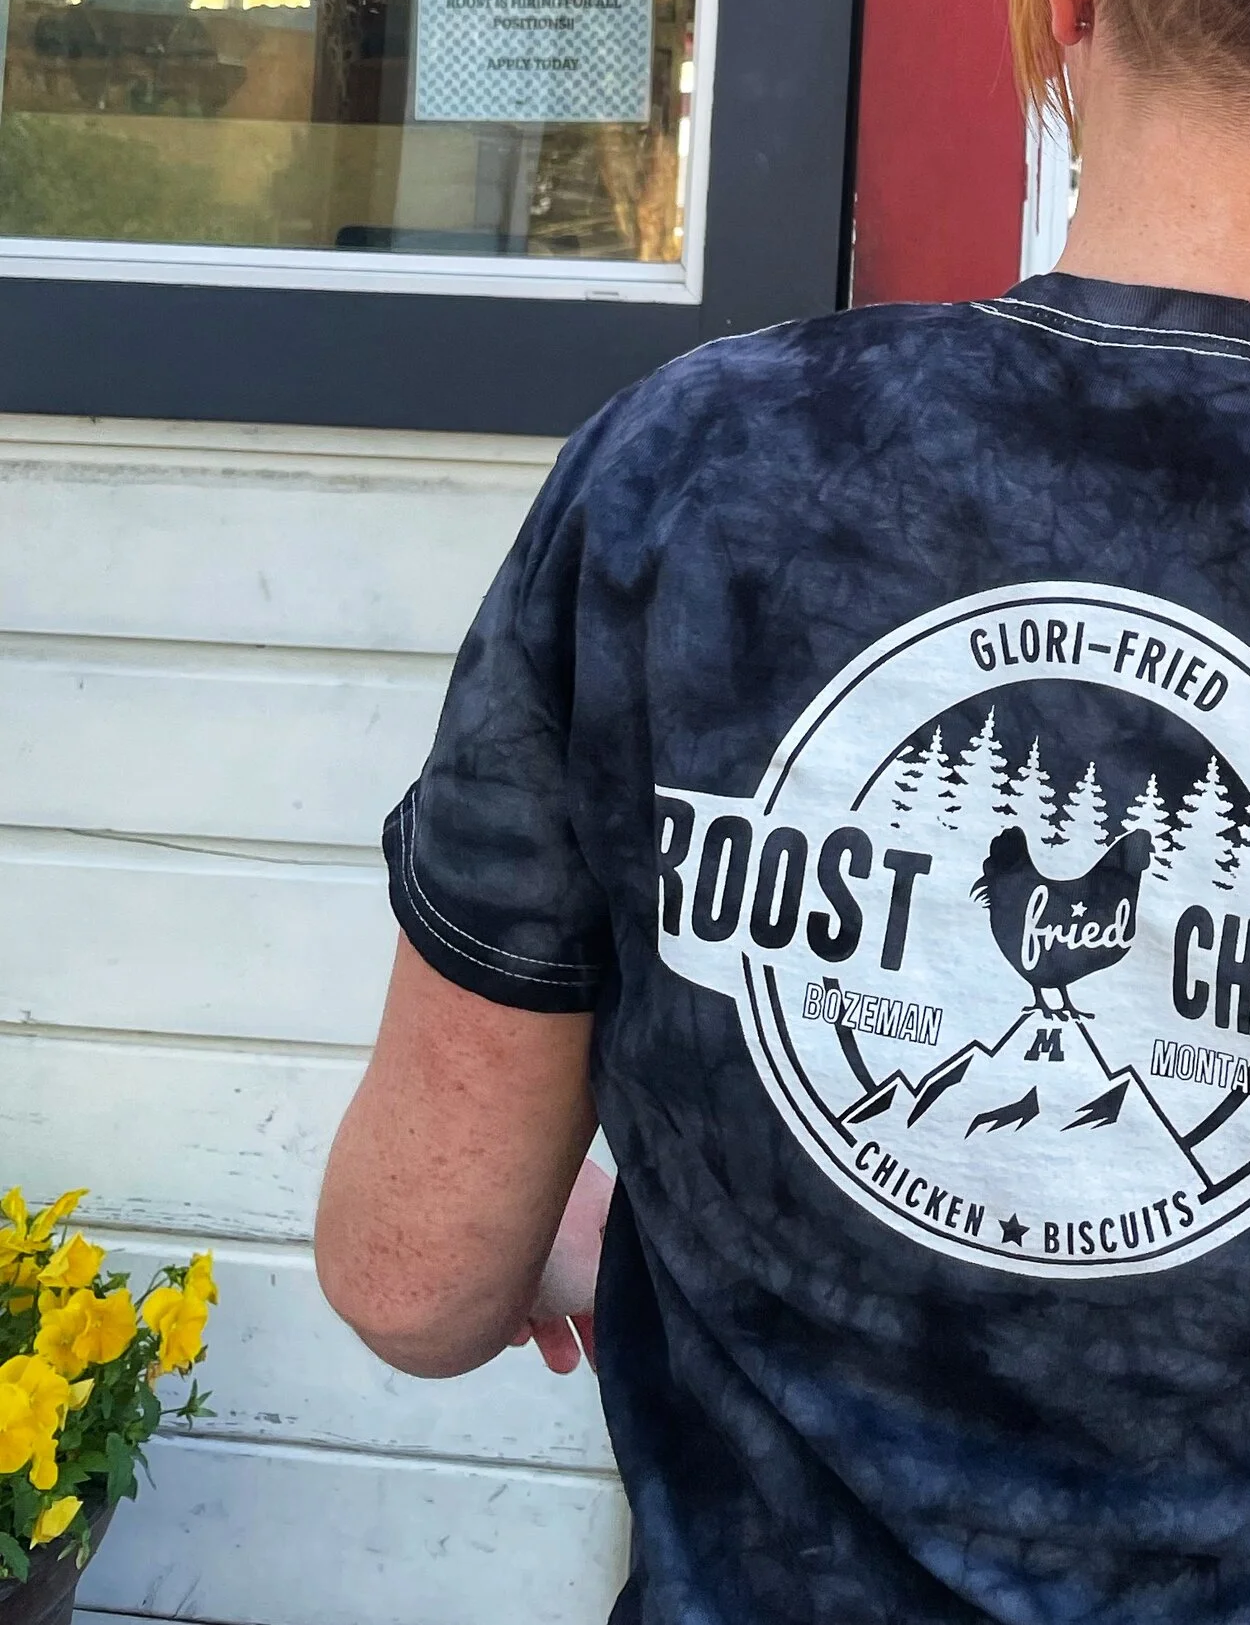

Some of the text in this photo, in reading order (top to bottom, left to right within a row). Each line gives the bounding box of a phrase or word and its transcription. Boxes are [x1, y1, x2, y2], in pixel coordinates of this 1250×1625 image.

[487, 58, 579, 70] APPLY TODAY
[970, 619, 1229, 712] GLORI-FRIED
[655, 794, 932, 971] ROOST
[1021, 885, 1132, 970] fried
[802, 982, 943, 1046] BOZEMAN
[854, 1141, 1195, 1255] CHICKEN BISCUITS
